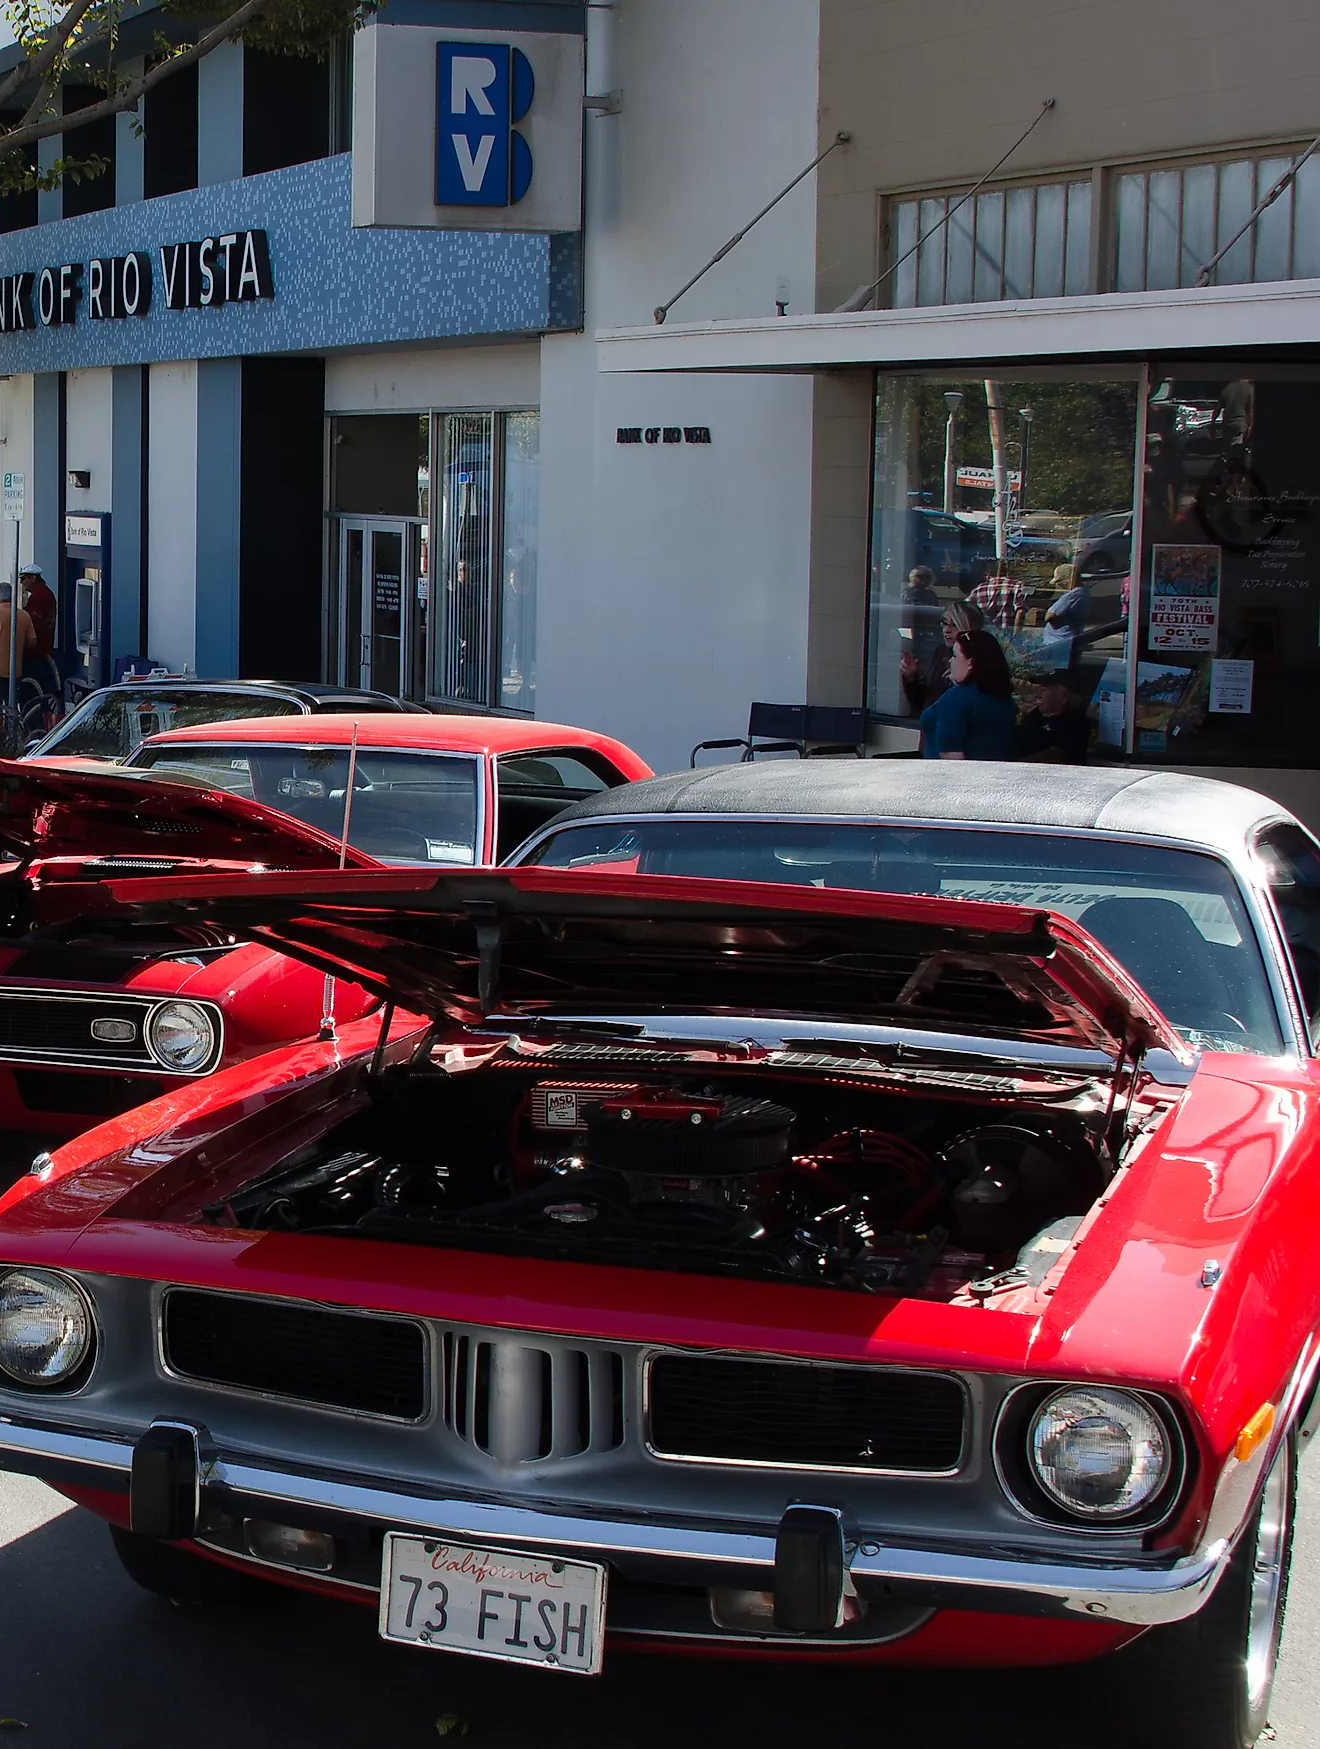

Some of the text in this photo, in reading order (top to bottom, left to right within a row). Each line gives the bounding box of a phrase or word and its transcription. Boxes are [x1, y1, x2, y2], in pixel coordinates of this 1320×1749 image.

[38, 263, 82, 327] OF
[88, 251, 151, 320] RIO
[161, 229, 275, 311] VISTA
[616, 427, 643, 444] BANK
[644, 427, 661, 444] OF
[683, 426, 712, 444] VISTA
[5, 474, 11, 486] 2
[4, 489, 23, 500] PARKING
[87, 527, 97, 537] Vista
[1154, 604, 1213, 613] RIO VISTA BASS
[1156, 614, 1209, 624] FESTIVAL
[1165, 628, 1199, 637] OCT.
[549, 1094, 574, 1108] MSD
[431, 1546, 563, 1589] California
[399, 1574, 588, 1657] 73 FISH
